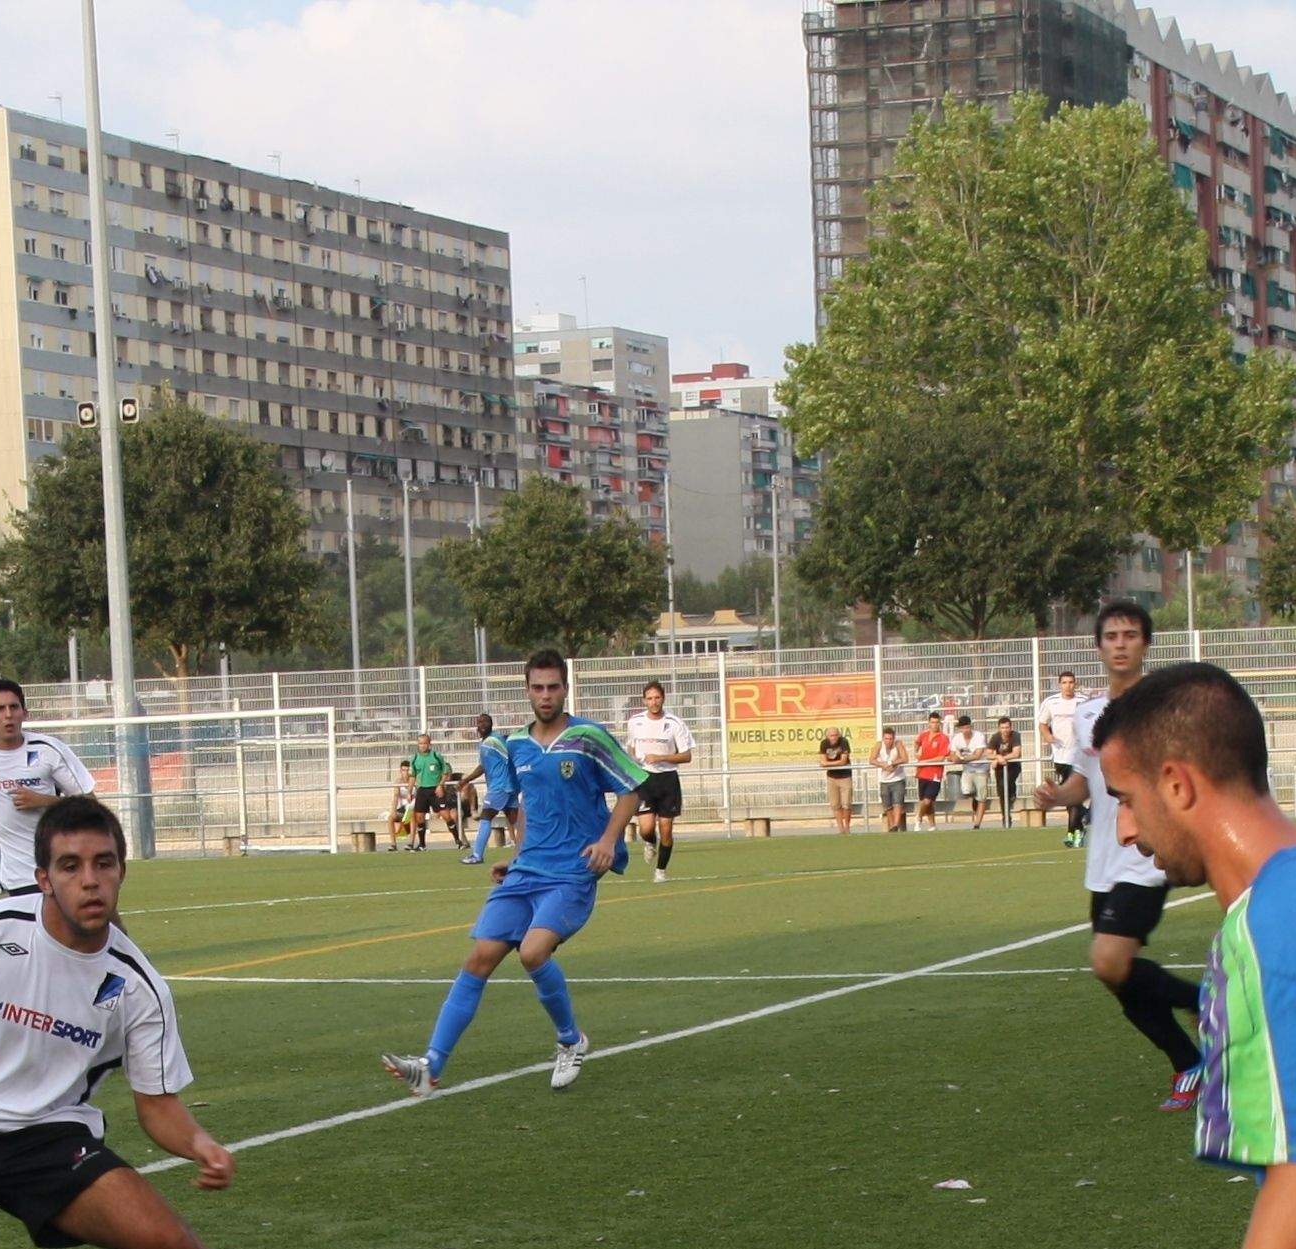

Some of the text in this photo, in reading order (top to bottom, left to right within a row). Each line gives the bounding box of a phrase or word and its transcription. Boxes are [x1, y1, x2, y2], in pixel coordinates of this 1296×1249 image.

[729, 728, 786, 744] MUEBLES
[788, 728, 804, 742] DE
[806, 726, 853, 741] COA
[1, 1002, 102, 1049] INTERSPORT
